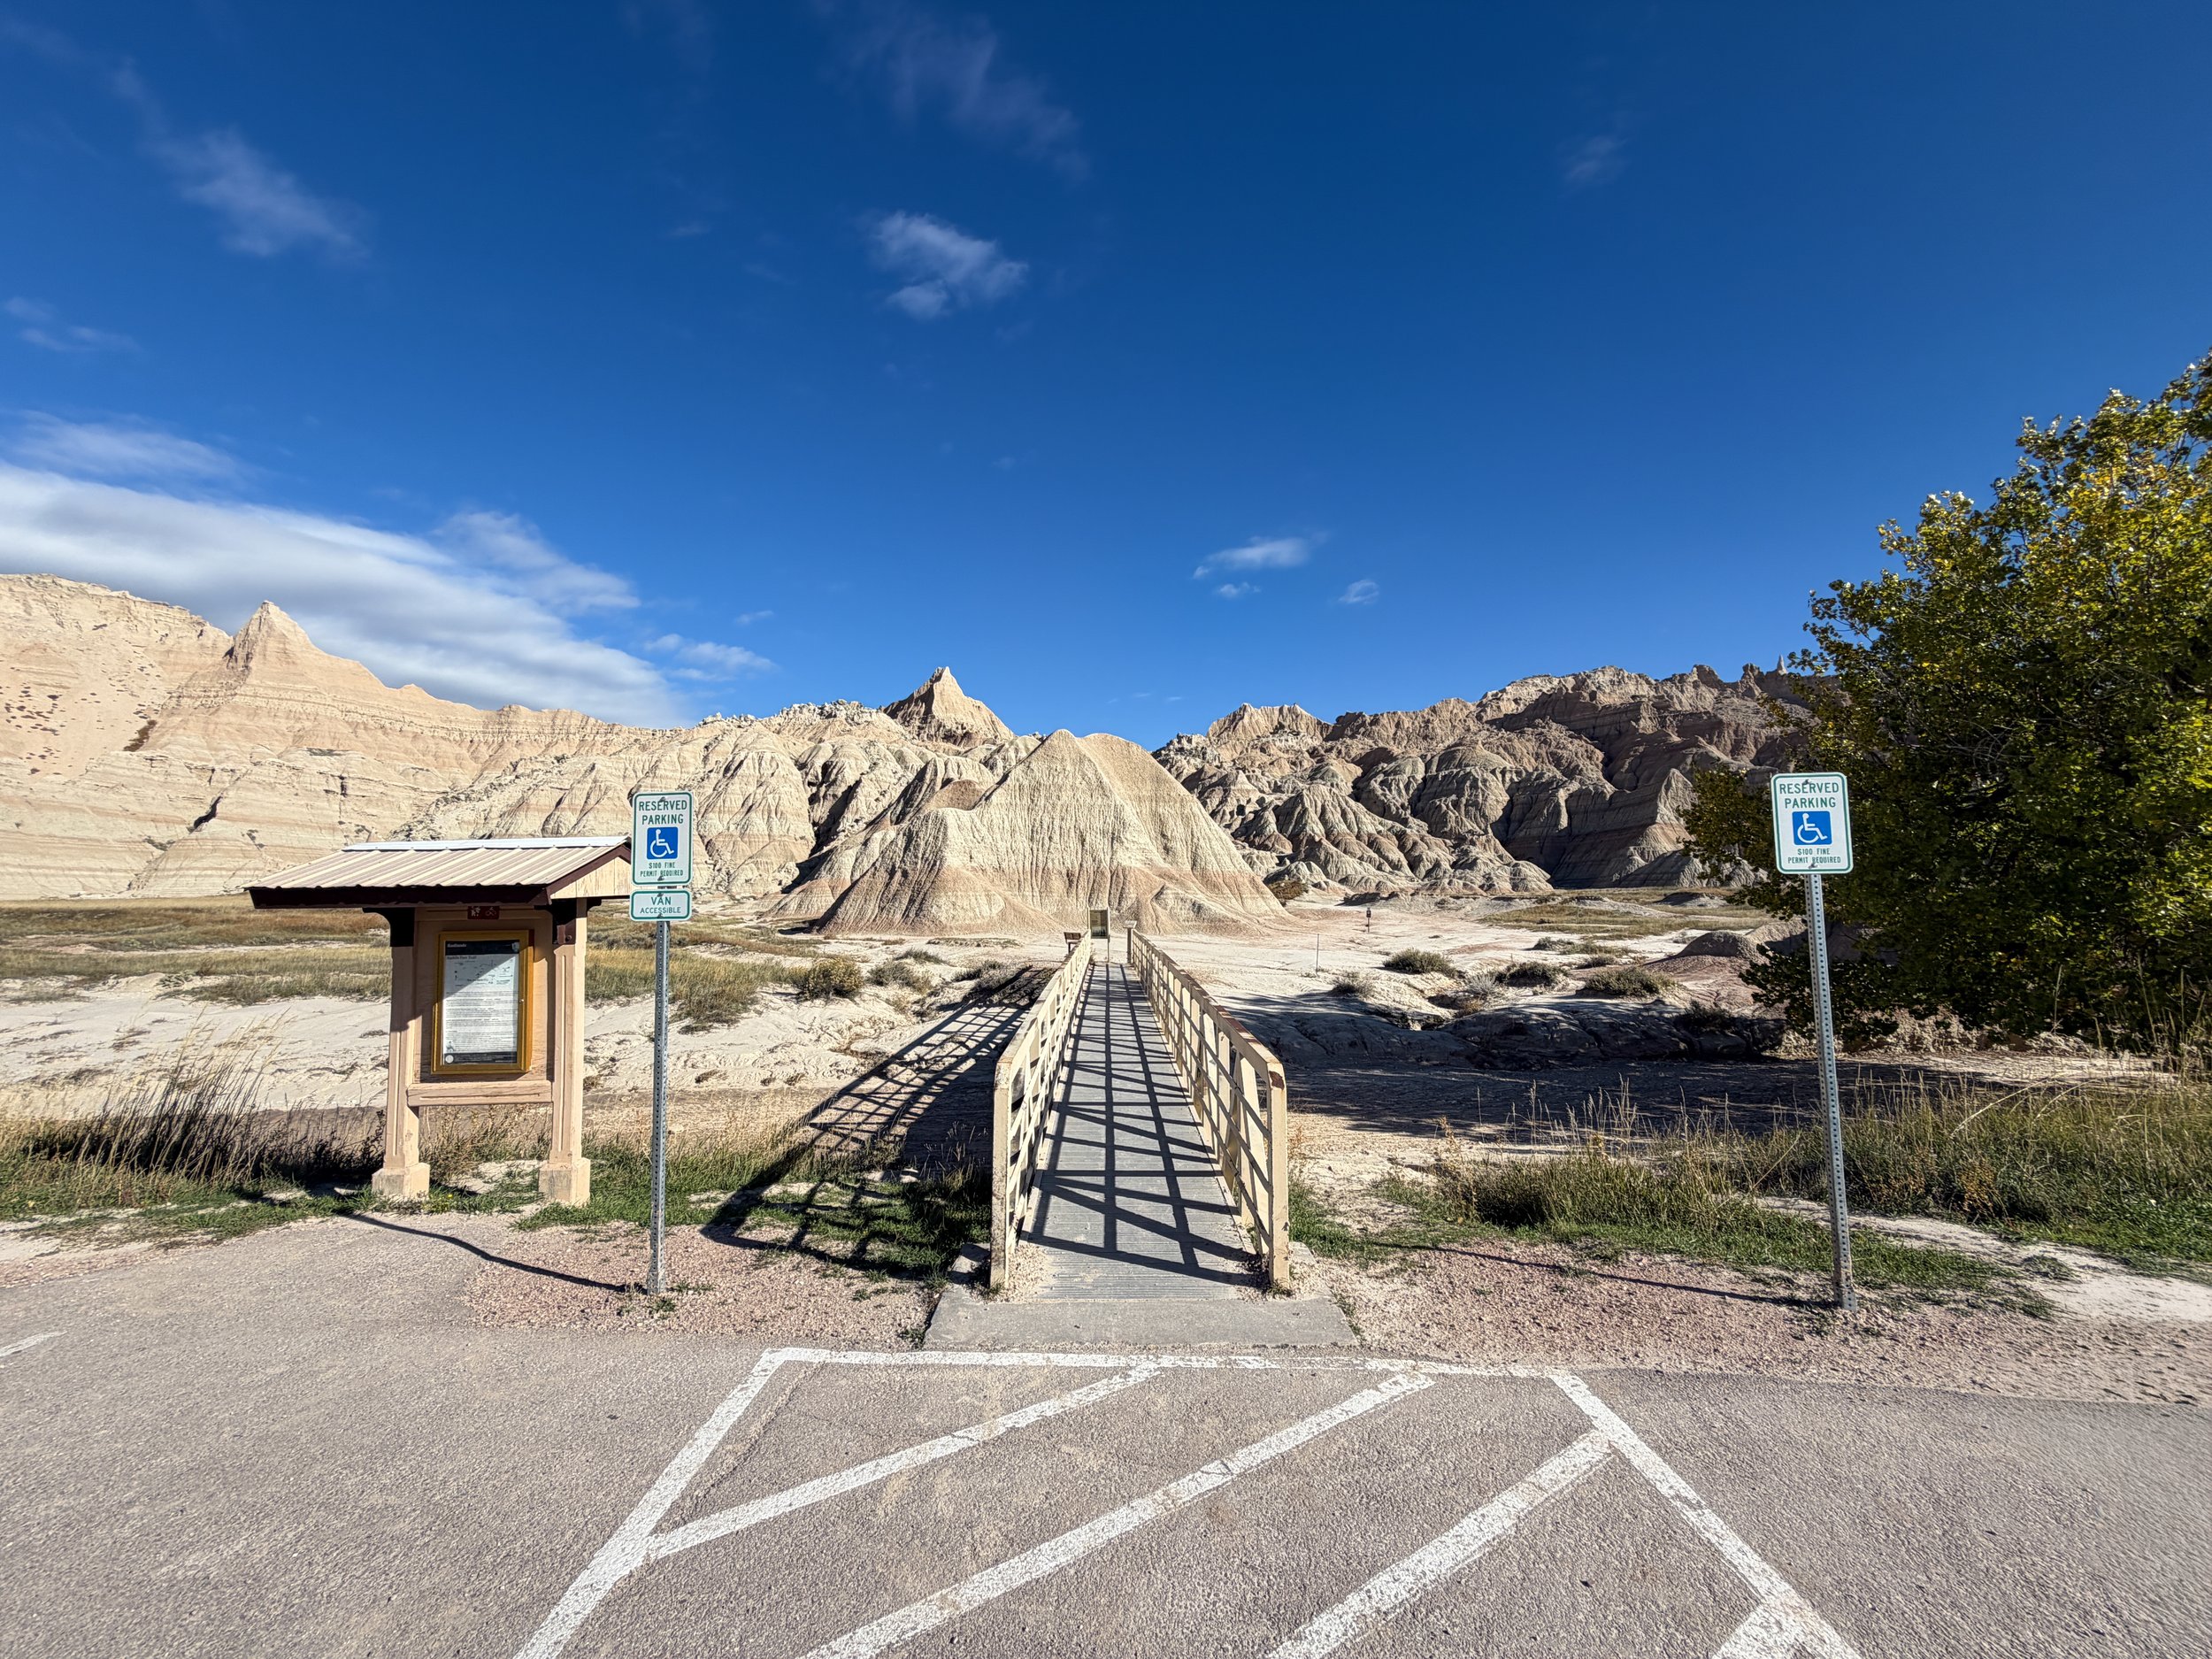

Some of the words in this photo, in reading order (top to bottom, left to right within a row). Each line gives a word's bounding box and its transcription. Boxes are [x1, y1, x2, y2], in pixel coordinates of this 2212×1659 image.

[1779, 782, 1839, 795] RESERVED
[638, 800, 687, 811] RESERVED
[1785, 796, 1836, 809] PARKING
[641, 814, 684, 825] PARKING
[651, 896, 672, 906] VAN
